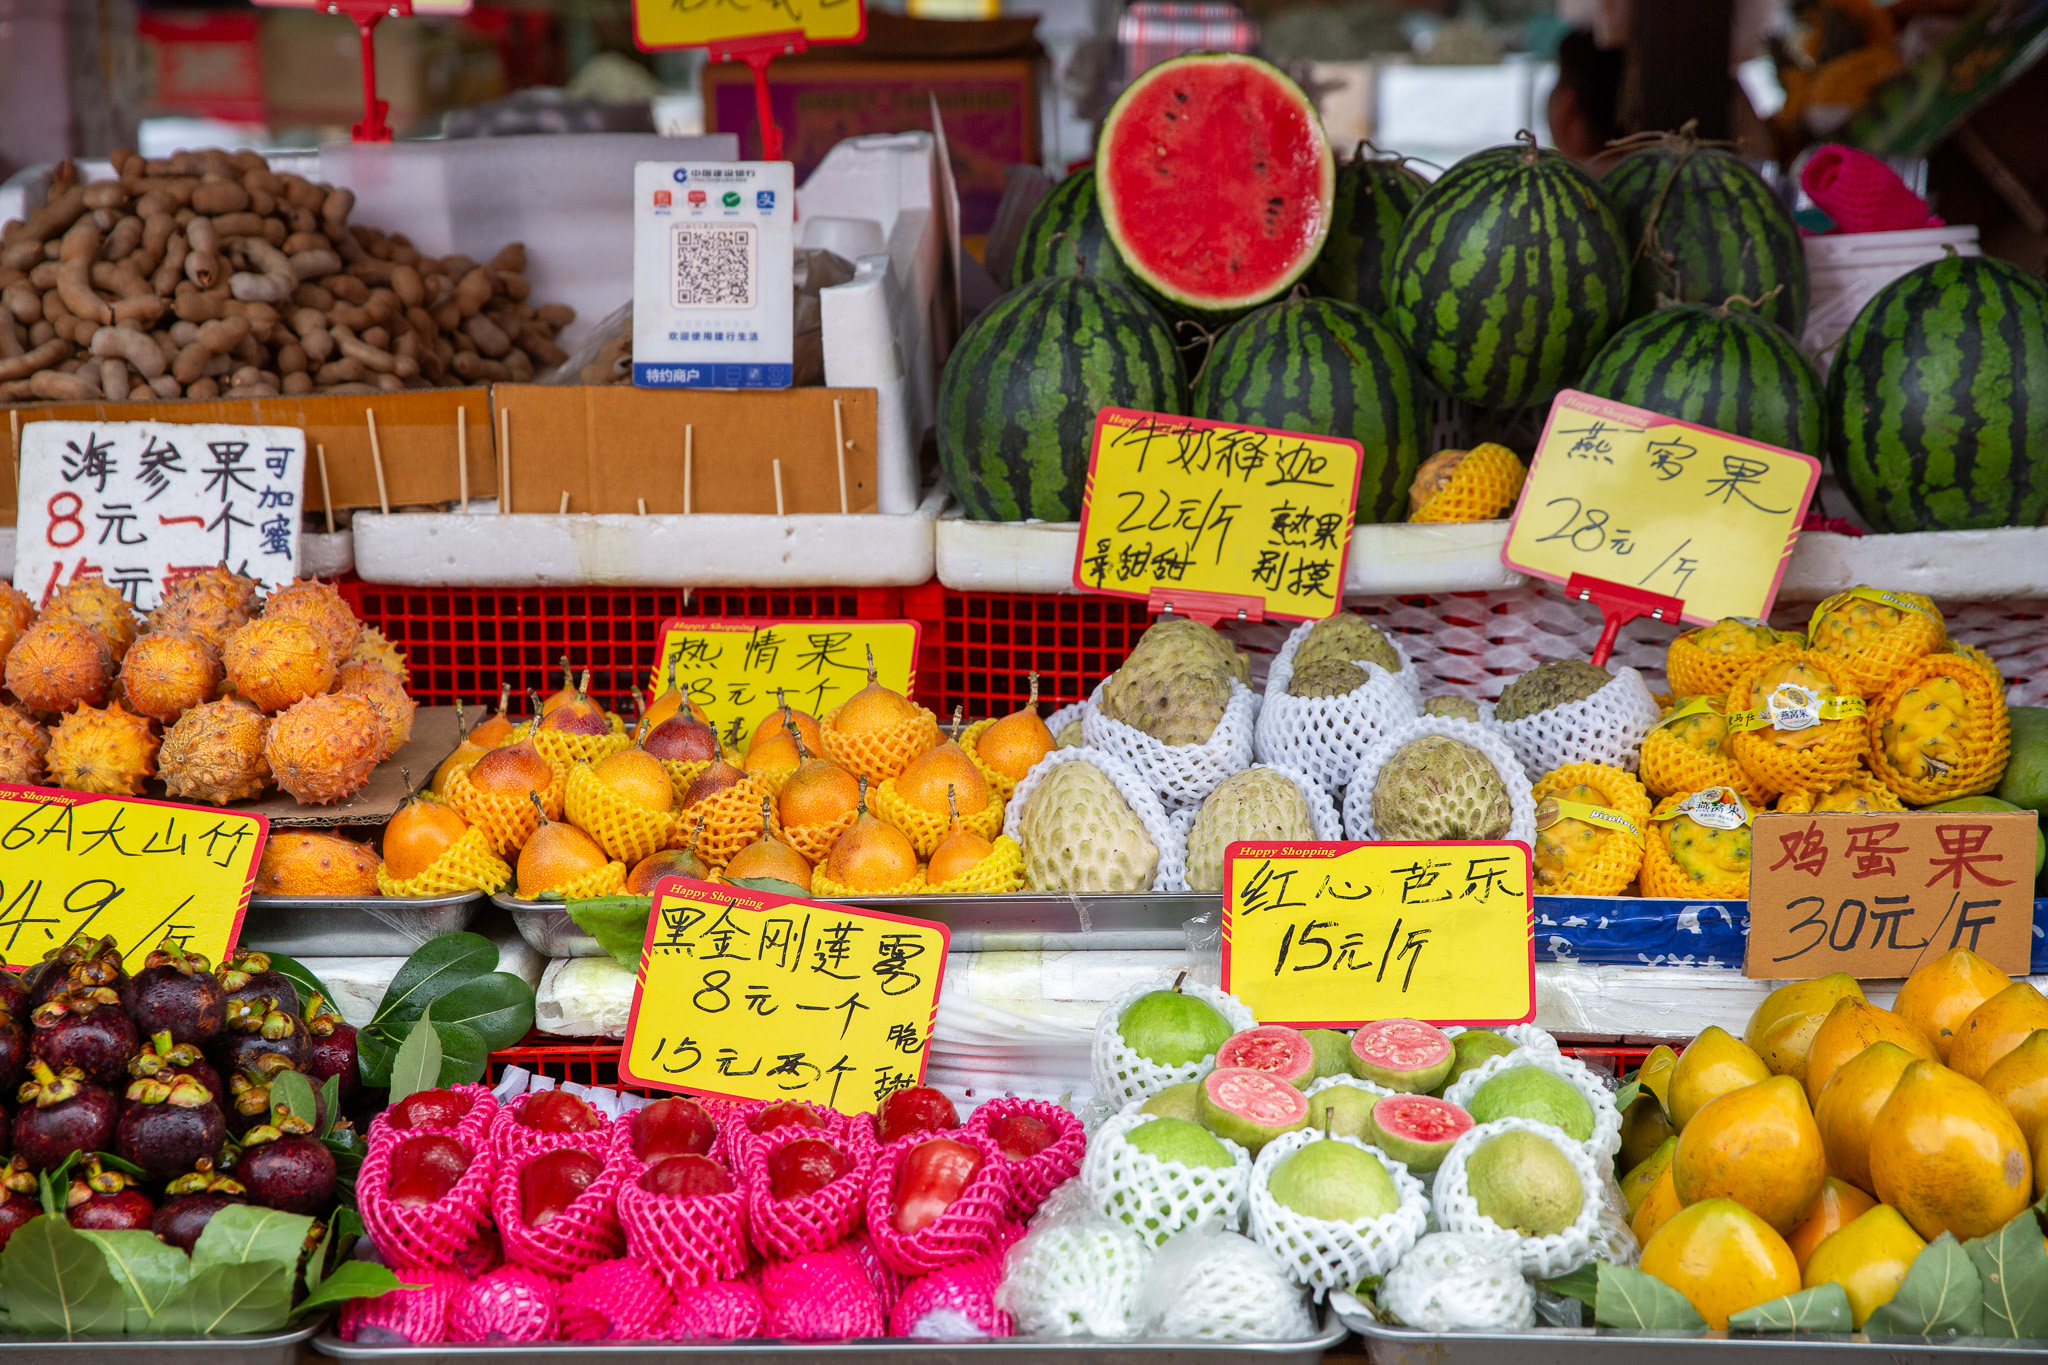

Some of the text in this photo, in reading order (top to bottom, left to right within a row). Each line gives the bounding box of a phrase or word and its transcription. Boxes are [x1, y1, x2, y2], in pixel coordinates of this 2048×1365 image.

[668, 331, 760, 341] 欢迎使用建行生活
[645, 368, 700, 383] 特约商户
[61, 431, 257, 502] 海参果
[46, 491, 255, 560] 8元一个
[257, 447, 296, 560] 可加蜜
[670, 626, 869, 675] 热情果
[20, 790, 78, 806] Shopping
[2, 800, 254, 867] 6A大山竹
[1239, 846, 1337, 858] Happy Shopping
[1769, 820, 2018, 889] 鸡蛋果
[668, 883, 765, 910] Happy Shopping
[1239, 857, 1525, 916] 红心芭乐
[1274, 918, 1432, 993] 15元/斤
[1772, 891, 2002, 976] 30元/斤
[692, 969, 870, 1041] 8元一个
